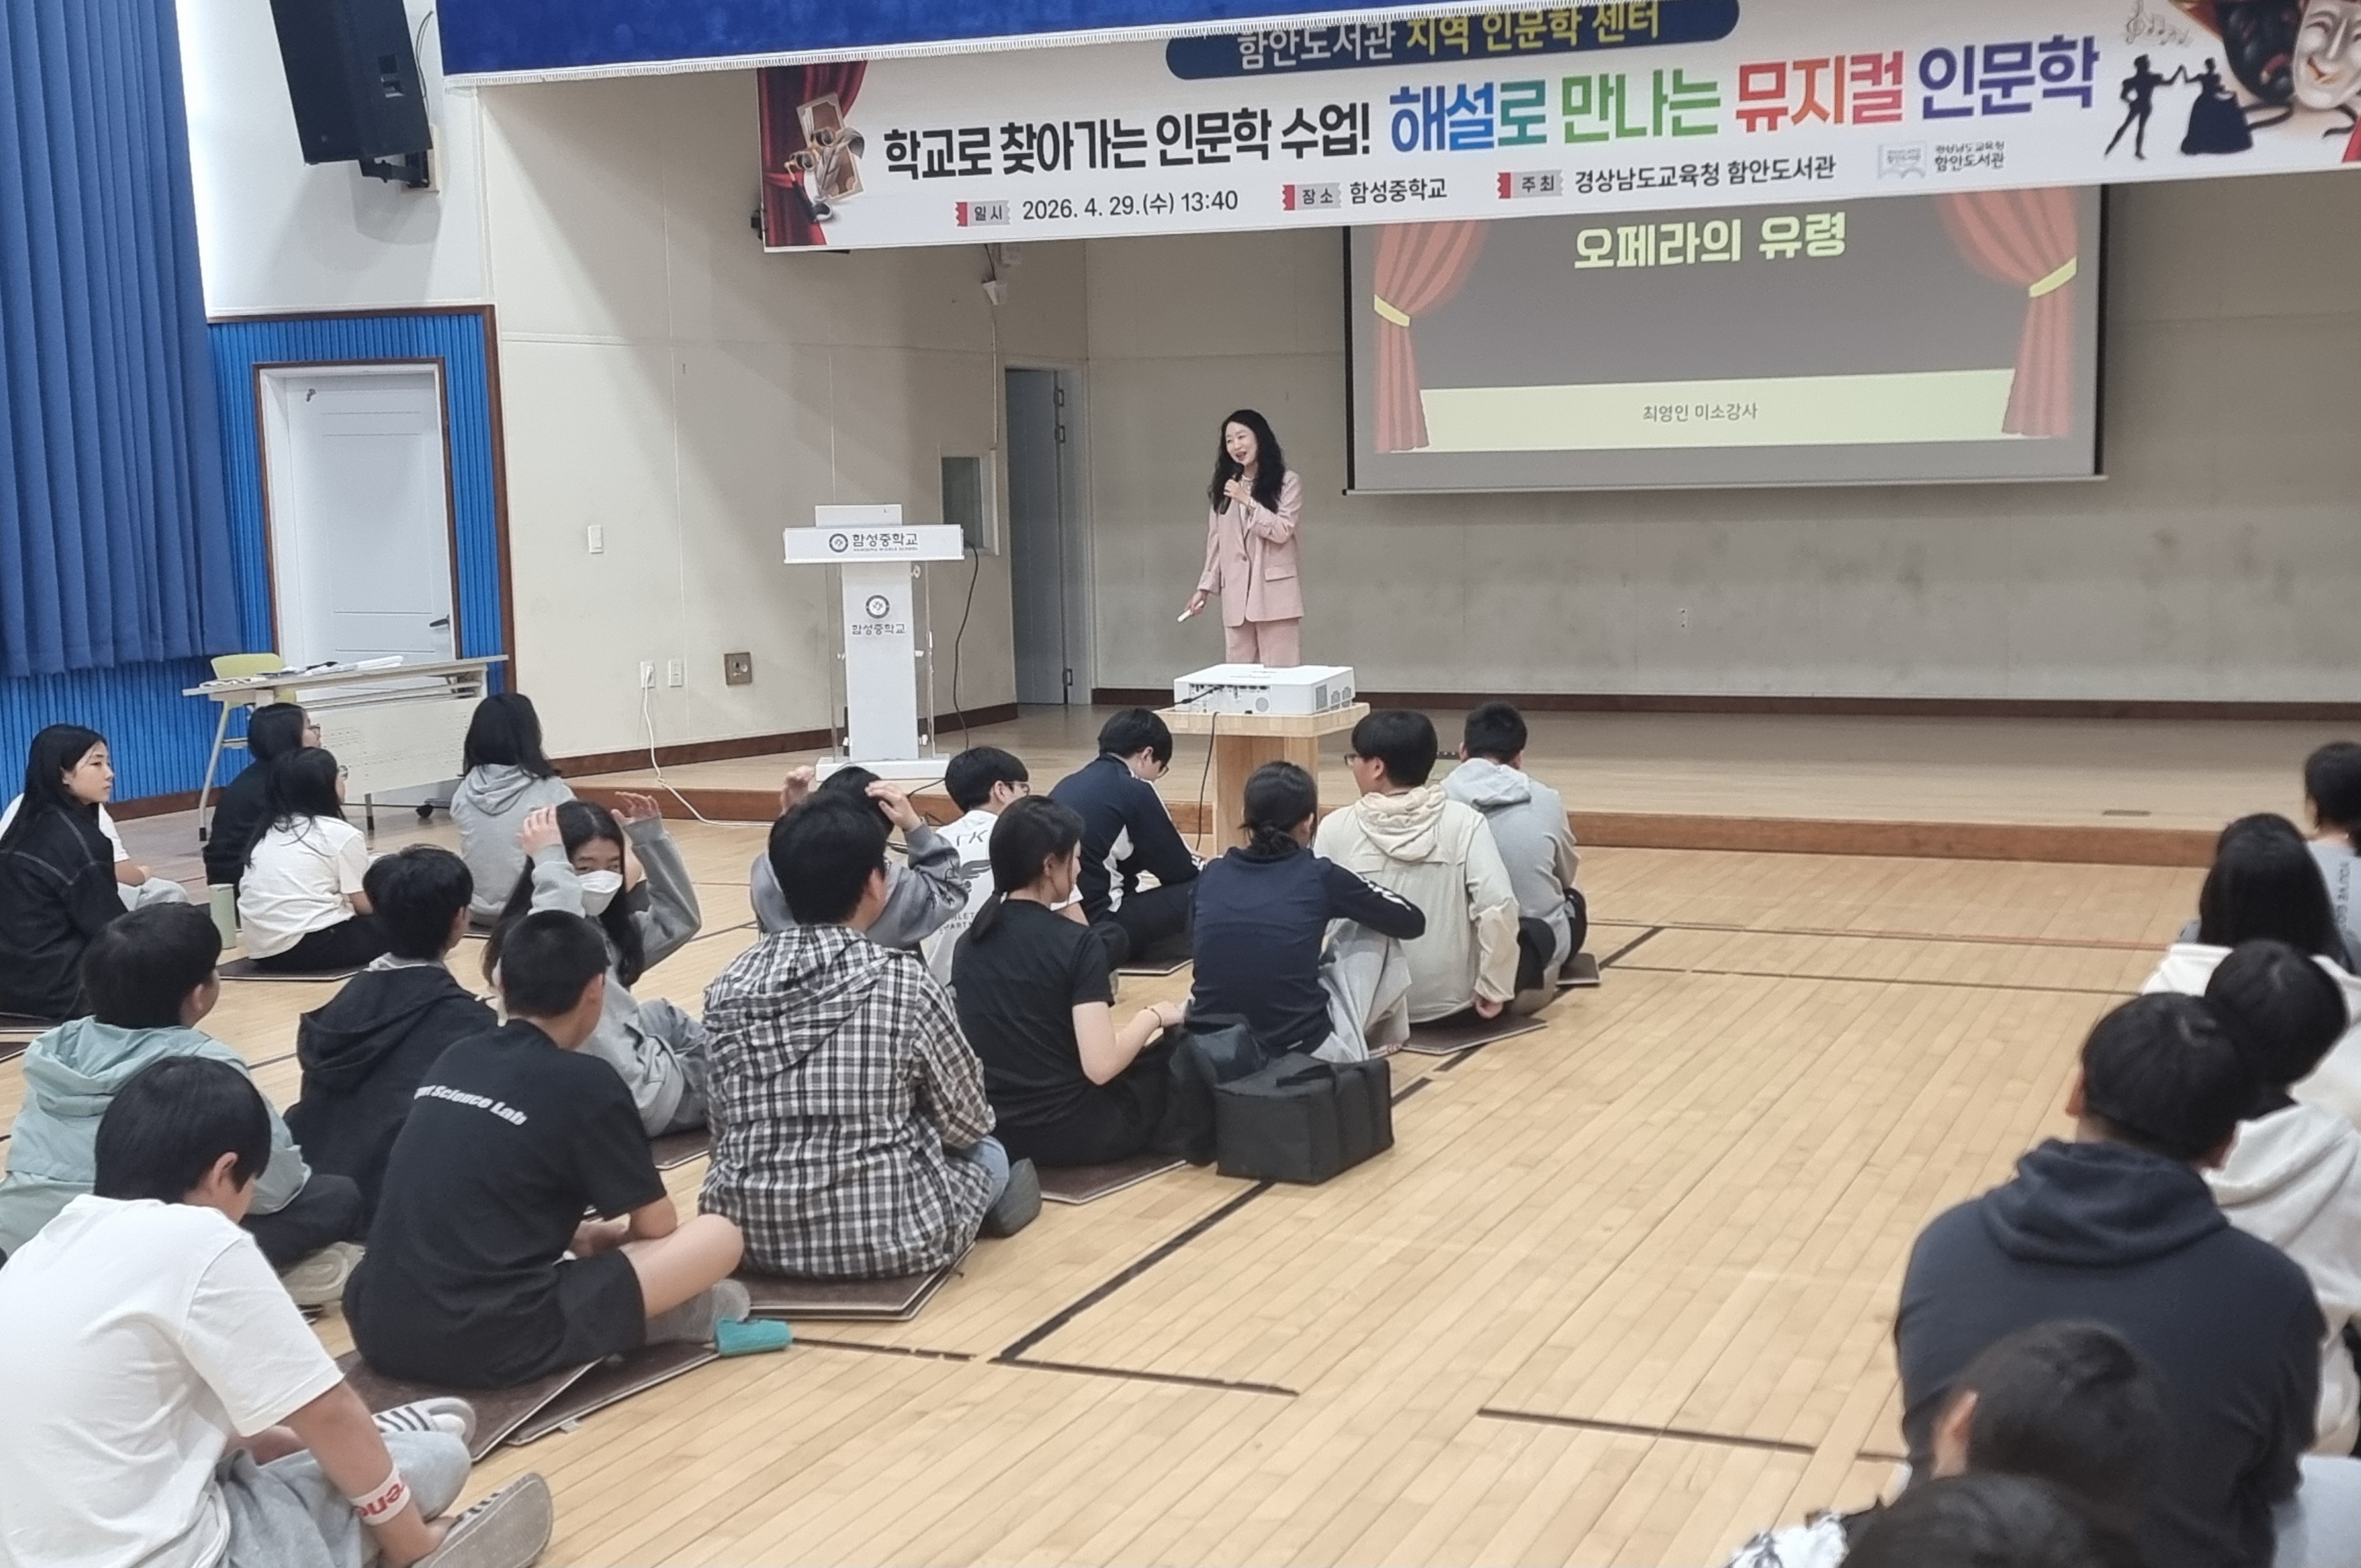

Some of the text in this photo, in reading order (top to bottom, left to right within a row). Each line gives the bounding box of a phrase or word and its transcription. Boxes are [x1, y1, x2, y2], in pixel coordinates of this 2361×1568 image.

[1237, 1, 1659, 69] 함안도서관 지역 인문학 센터
[884, 34, 2100, 179] 학교로 찾아가는 인문학 수업! 해설로 만나는 뮤지컬 인문학
[1574, 161, 1720, 194] 경상남도교육청
[1727, 154, 1837, 185] 함안도서관
[1022, 199, 1079, 220] 2026.
[1084, 197, 1103, 217] 4.
[1109, 192, 1174, 217] 29.(수)
[1180, 189, 1238, 212] 13:40
[1350, 177, 1448, 205] 함성중학교
[1574, 212, 1846, 269] 오페라의 유령
[1643, 402, 1759, 423] 최영인 미소강사
[851, 532, 919, 547] 함성중학교
[851, 623, 906, 636] 함성중학교
[490, 1101, 528, 1126] Lab
